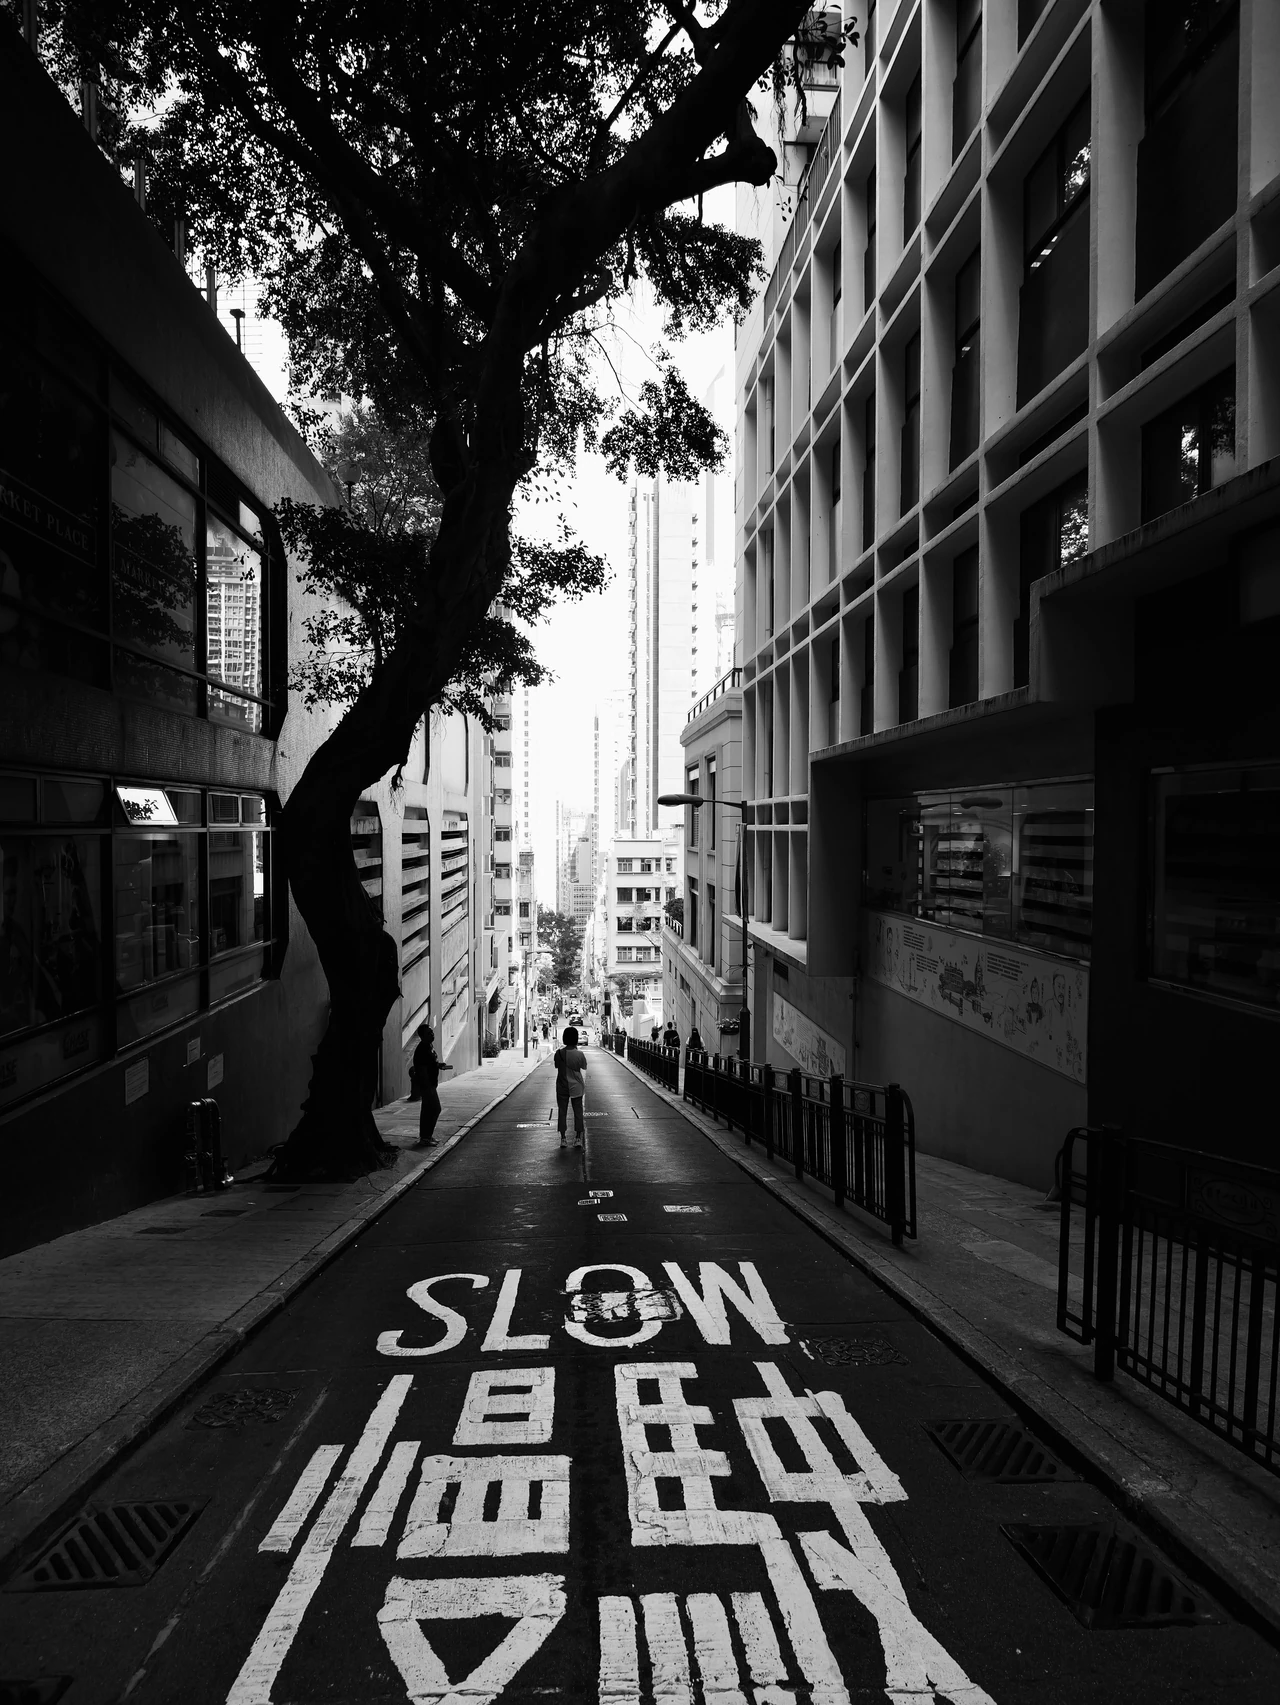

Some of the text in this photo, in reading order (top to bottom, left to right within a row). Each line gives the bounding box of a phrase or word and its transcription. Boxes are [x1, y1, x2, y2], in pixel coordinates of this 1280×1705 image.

[47, 512, 89, 551] PLACE
[376, 1261, 791, 1358] SLOW
[226, 1361, 999, 1705] 慢駛
